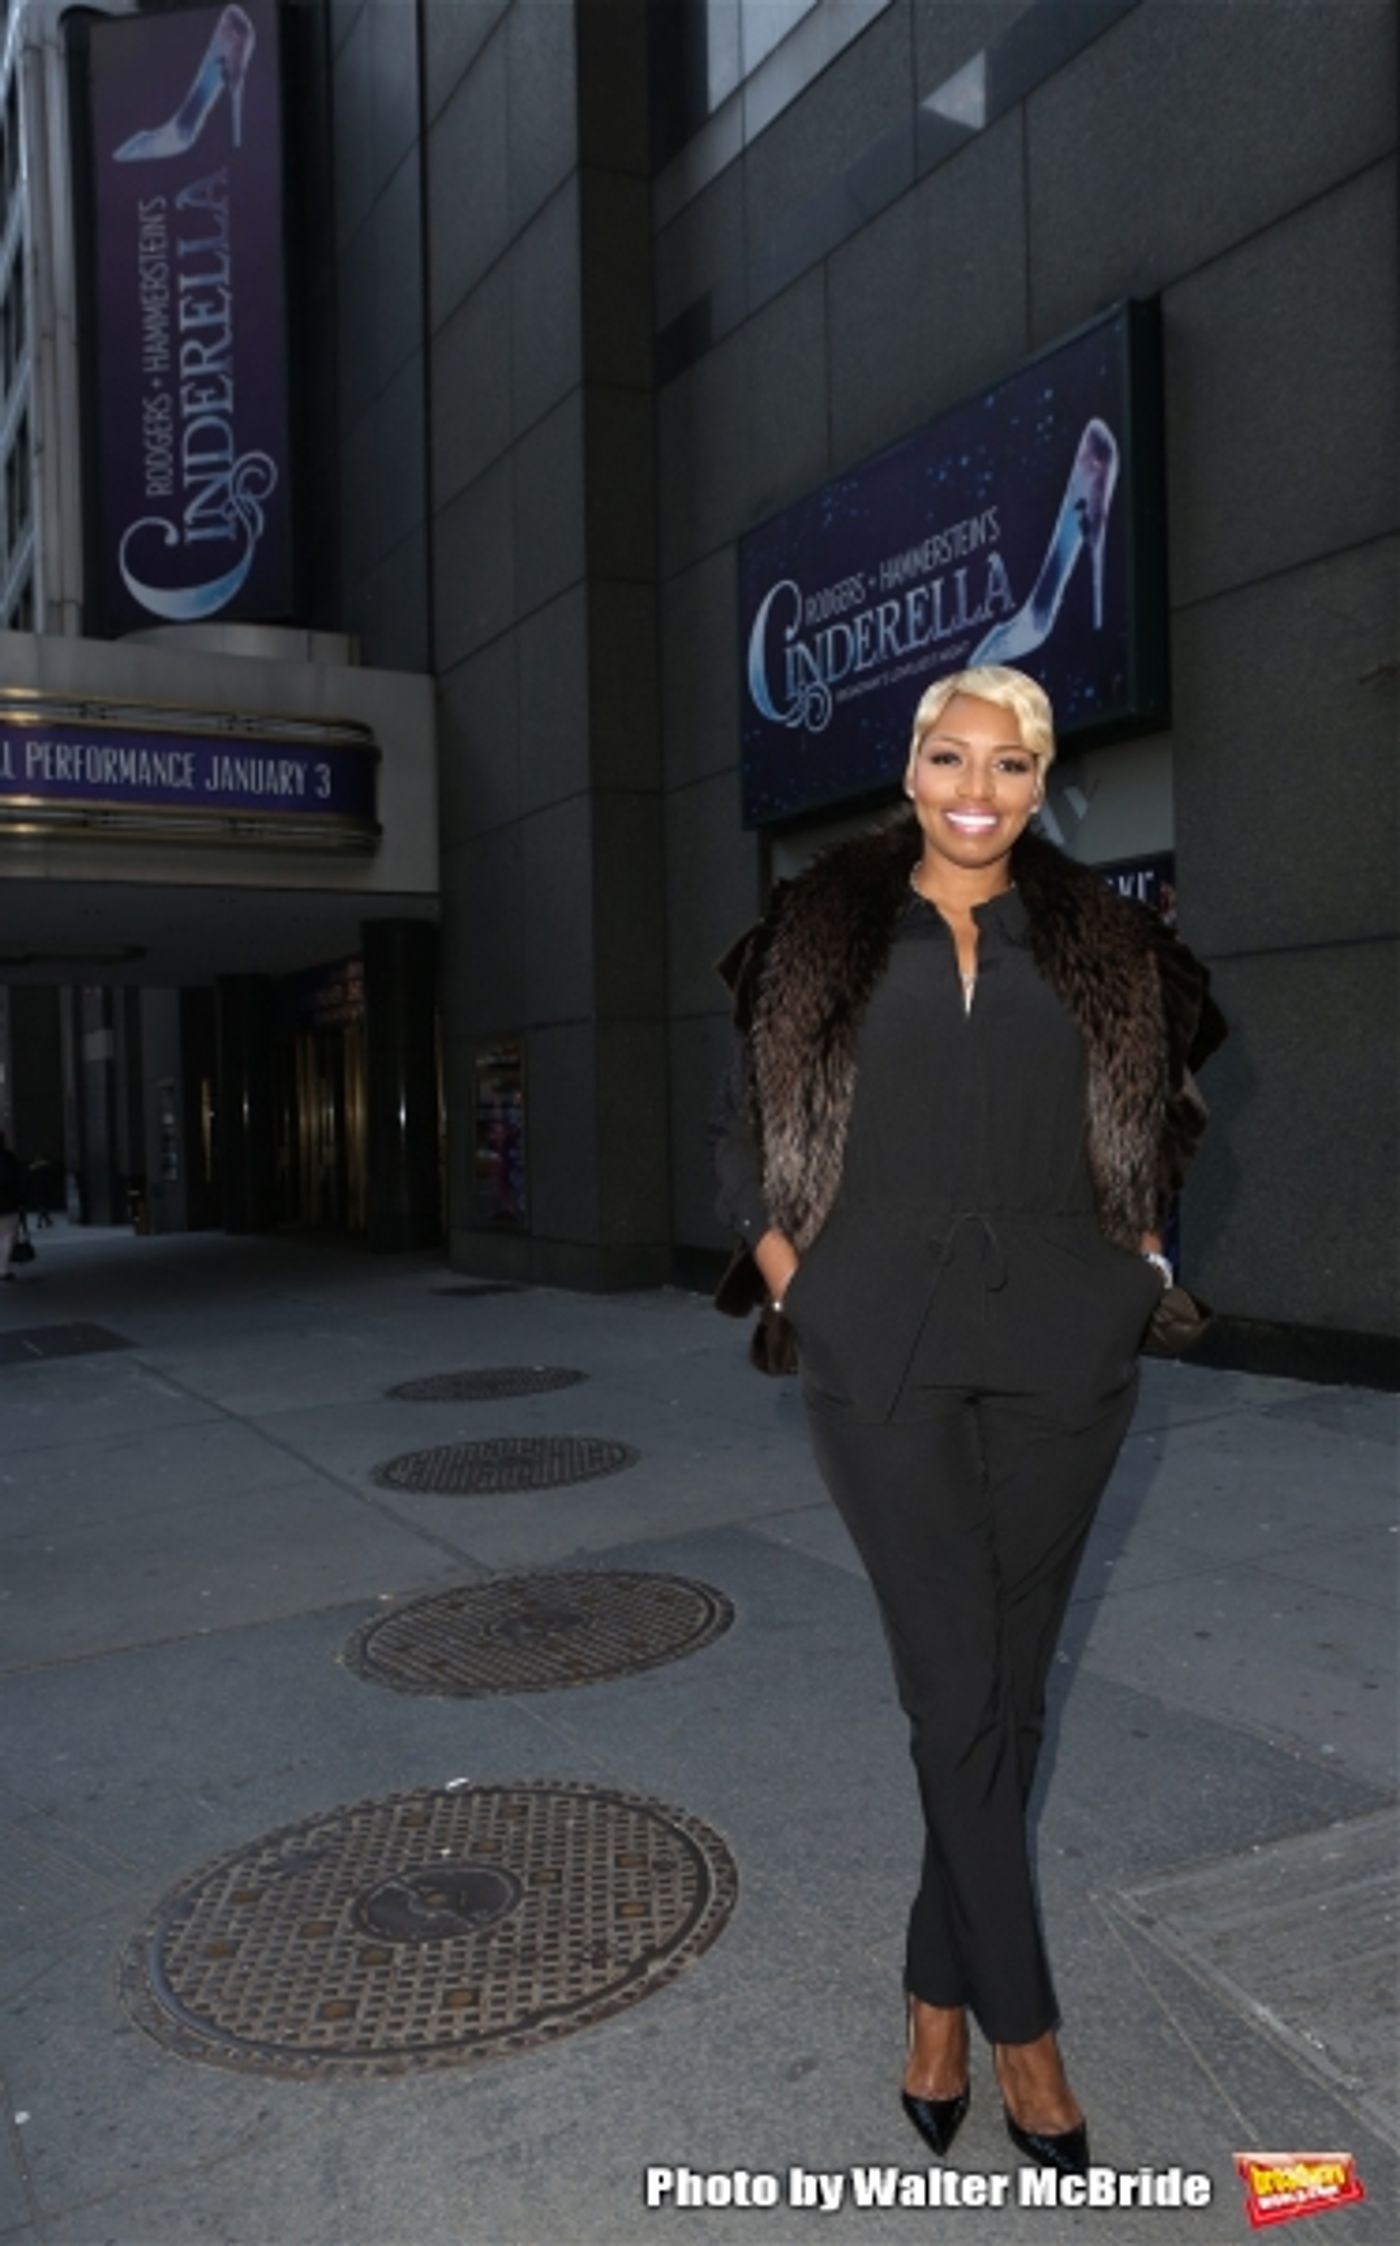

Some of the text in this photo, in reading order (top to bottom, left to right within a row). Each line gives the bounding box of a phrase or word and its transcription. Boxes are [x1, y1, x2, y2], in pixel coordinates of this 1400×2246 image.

[138, 195, 170, 372] HAMMERSTEIN'S
[119, 165, 278, 621] CINDERELLA
[144, 394, 174, 497] RODGERS
[748, 551, 1016, 732] CINDERELLA
[805, 572, 866, 626] RODGERS
[26, 741, 195, 789] PERFORMANCE
[205, 755, 308, 796] JANUARY
[315, 764, 331, 799] 3
